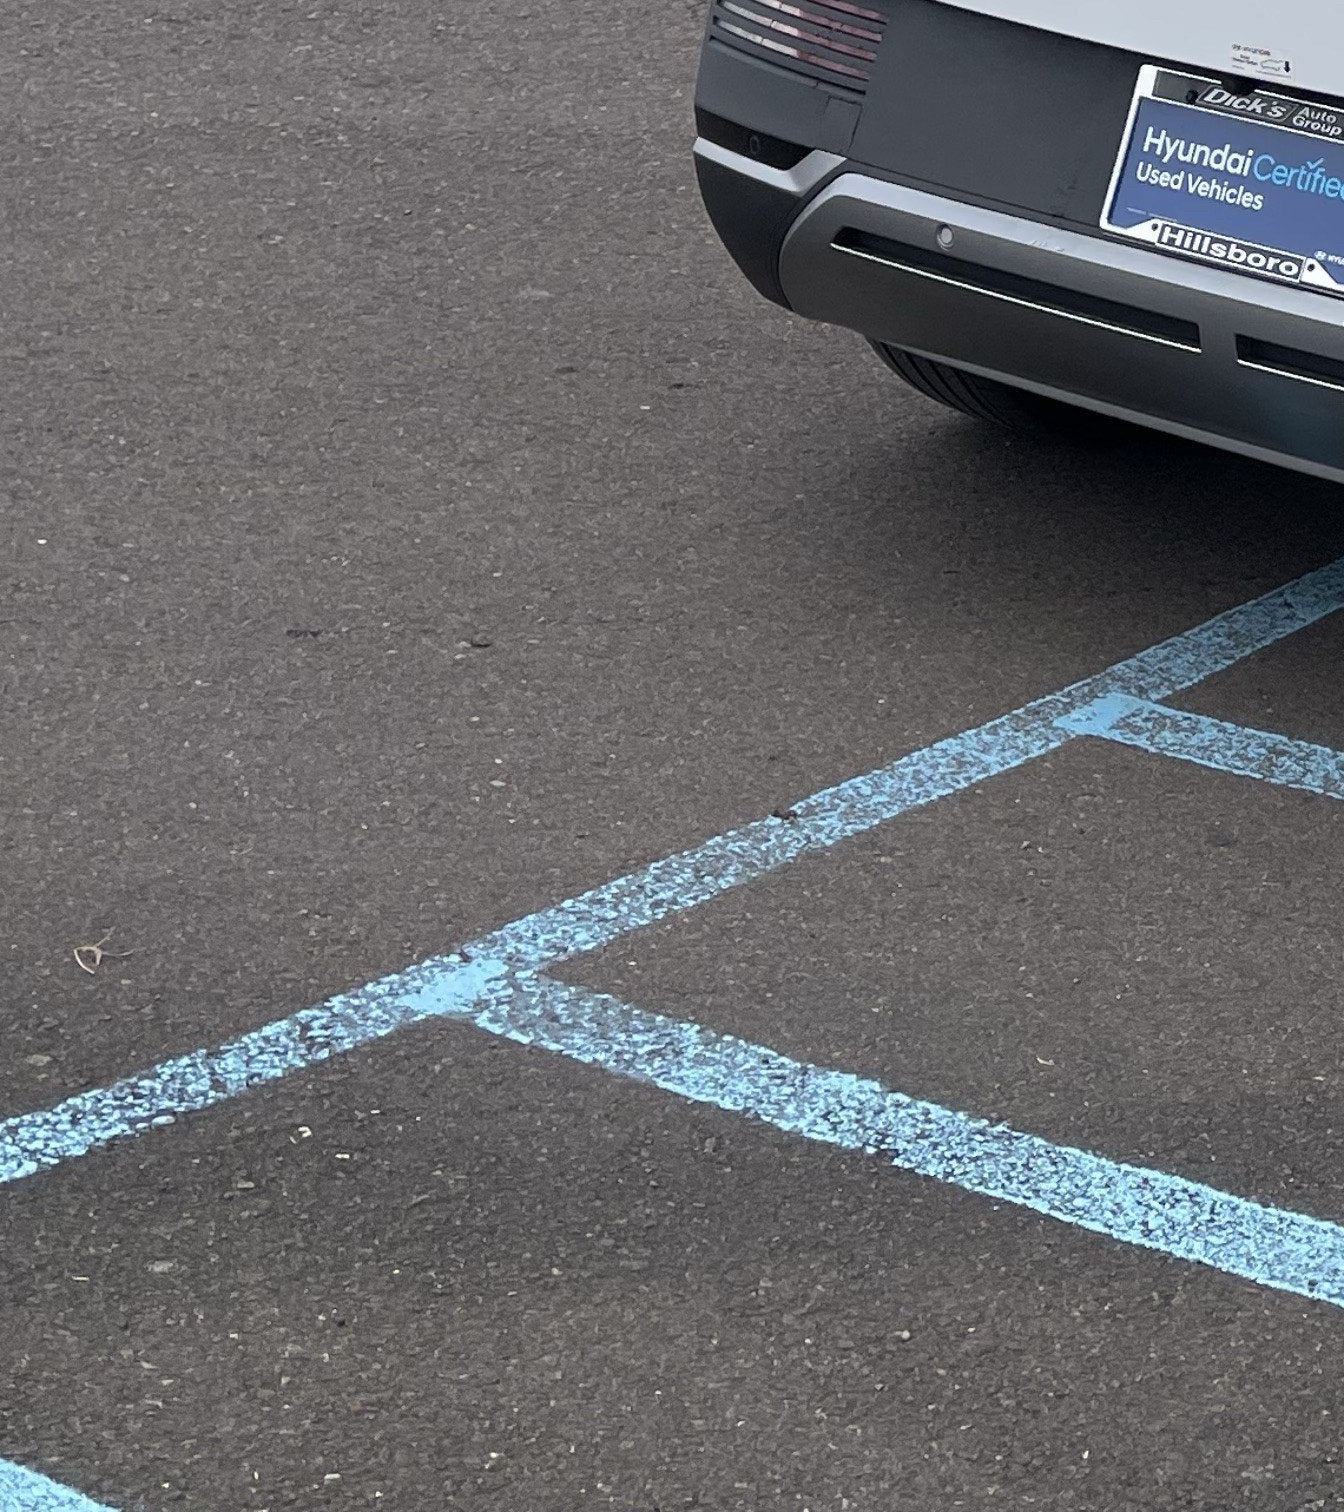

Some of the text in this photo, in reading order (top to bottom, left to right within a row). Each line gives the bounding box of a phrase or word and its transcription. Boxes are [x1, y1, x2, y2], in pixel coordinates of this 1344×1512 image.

[1203, 87, 1287, 118] Dick's
[1299, 105, 1338, 124] Auto
[1292, 115, 1343, 138] Group
[1143, 126, 1254, 177] Hyundai
[1136, 161, 1264, 211] Used Vehicles
[1160, 224, 1300, 277] Hillsboro
